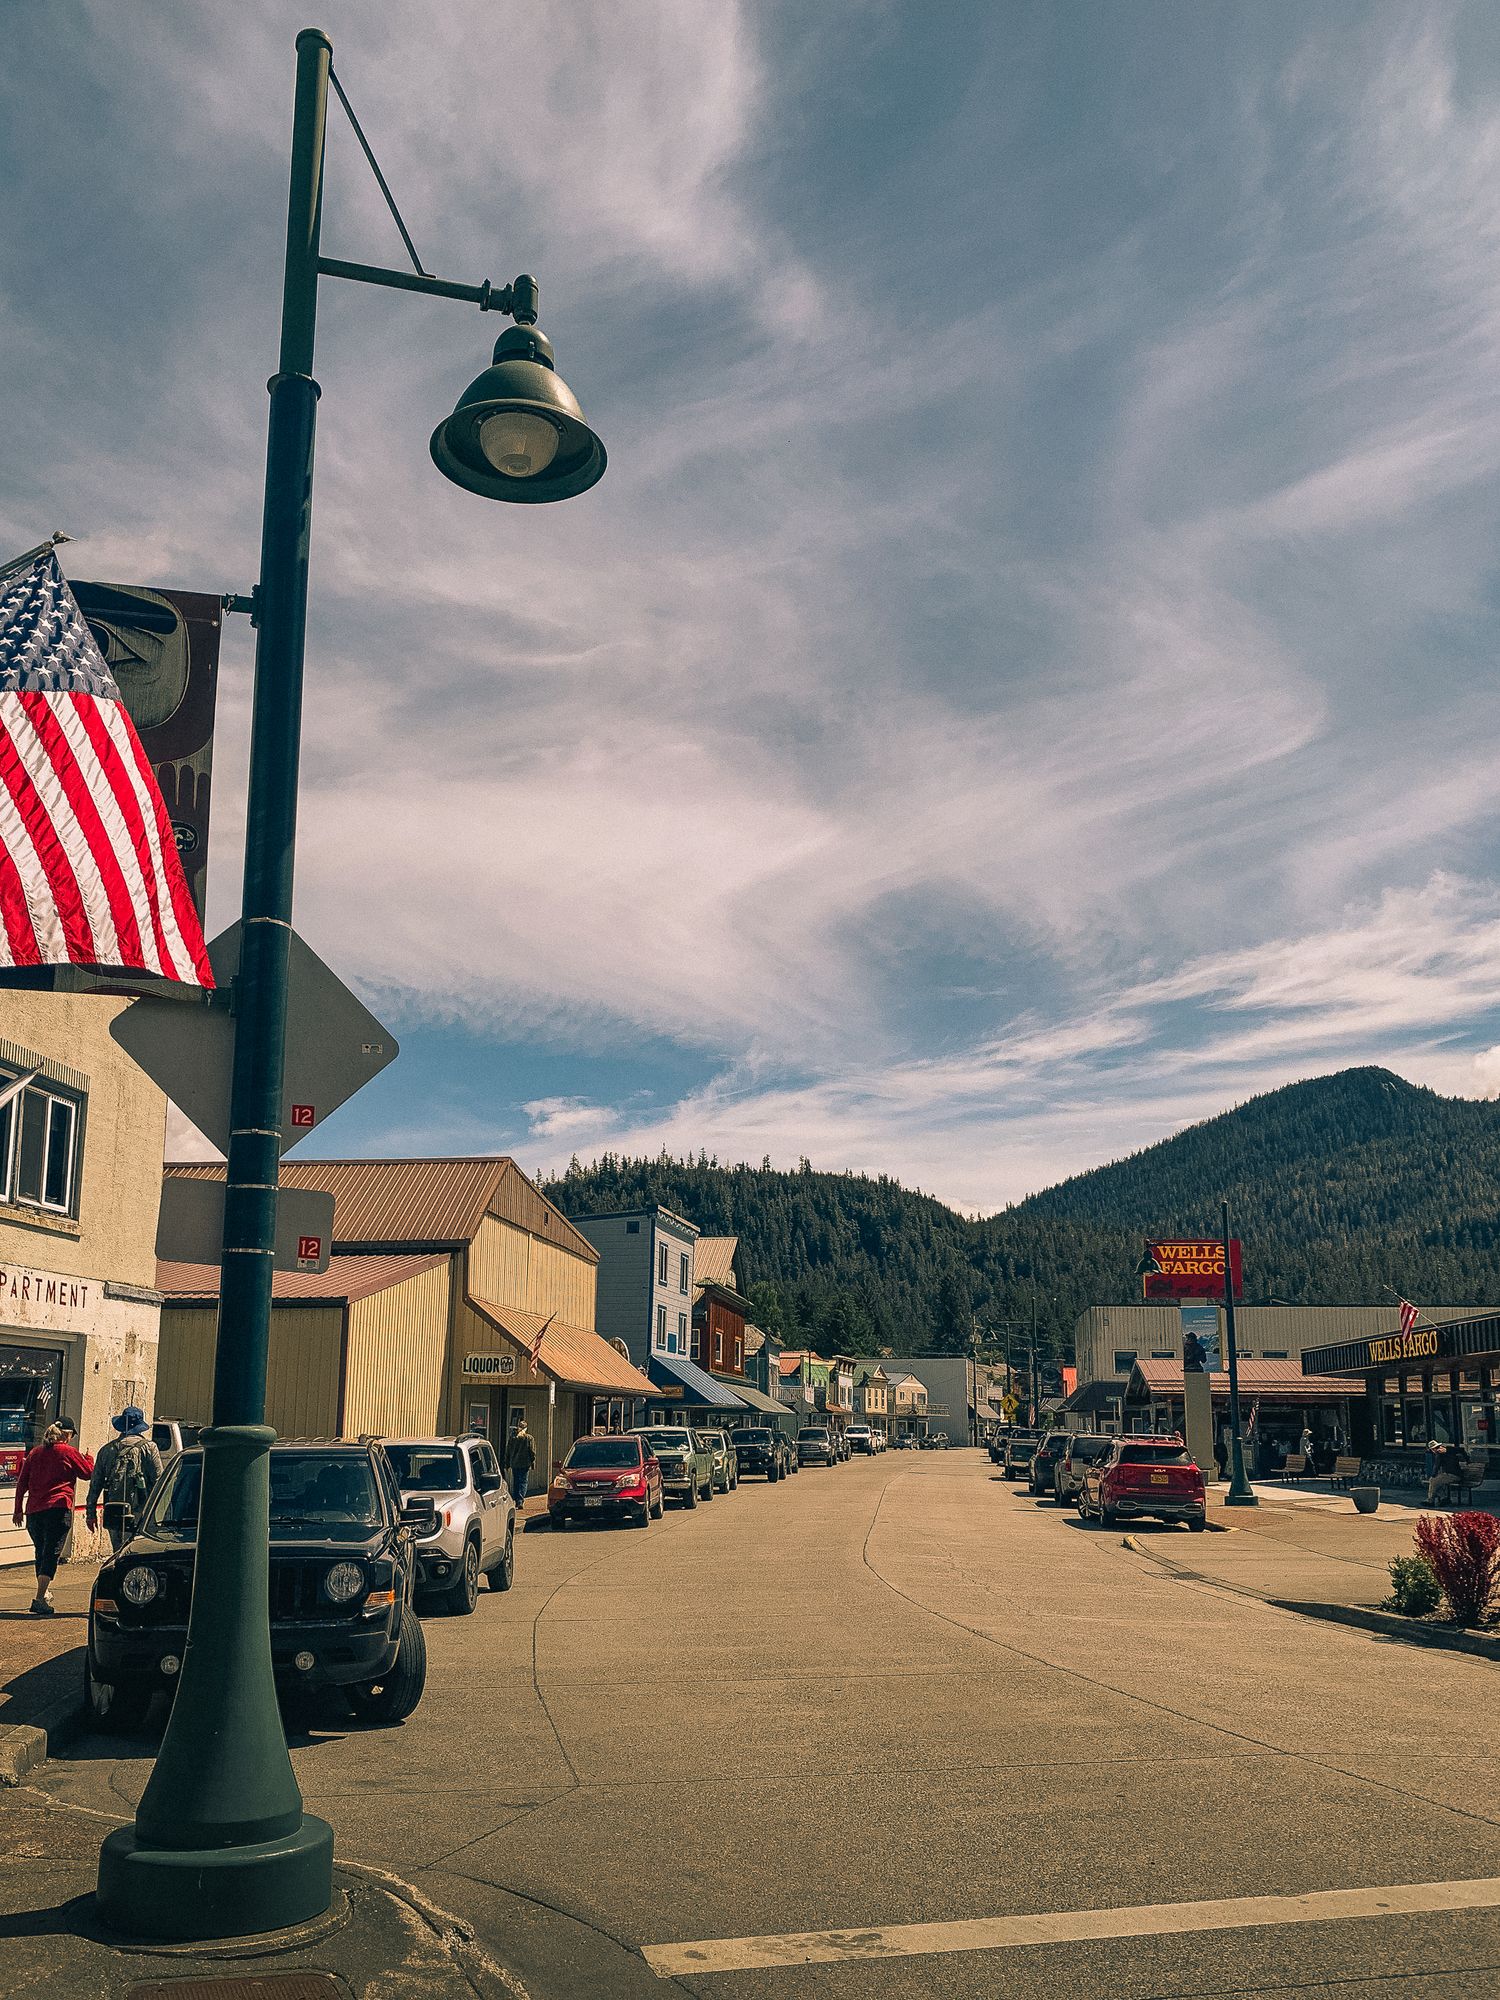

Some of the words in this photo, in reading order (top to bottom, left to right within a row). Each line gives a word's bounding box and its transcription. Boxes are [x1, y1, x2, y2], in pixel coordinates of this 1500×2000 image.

[294, 1108, 312, 1124] 12
[301, 1240, 318, 1256] 12
[1156, 1245, 1226, 1259] WELLS
[1368, 1336, 1402, 1362] WELLS
[1402, 1330, 1438, 1358] FARGO
[463, 1357, 500, 1373] LIQUOR
